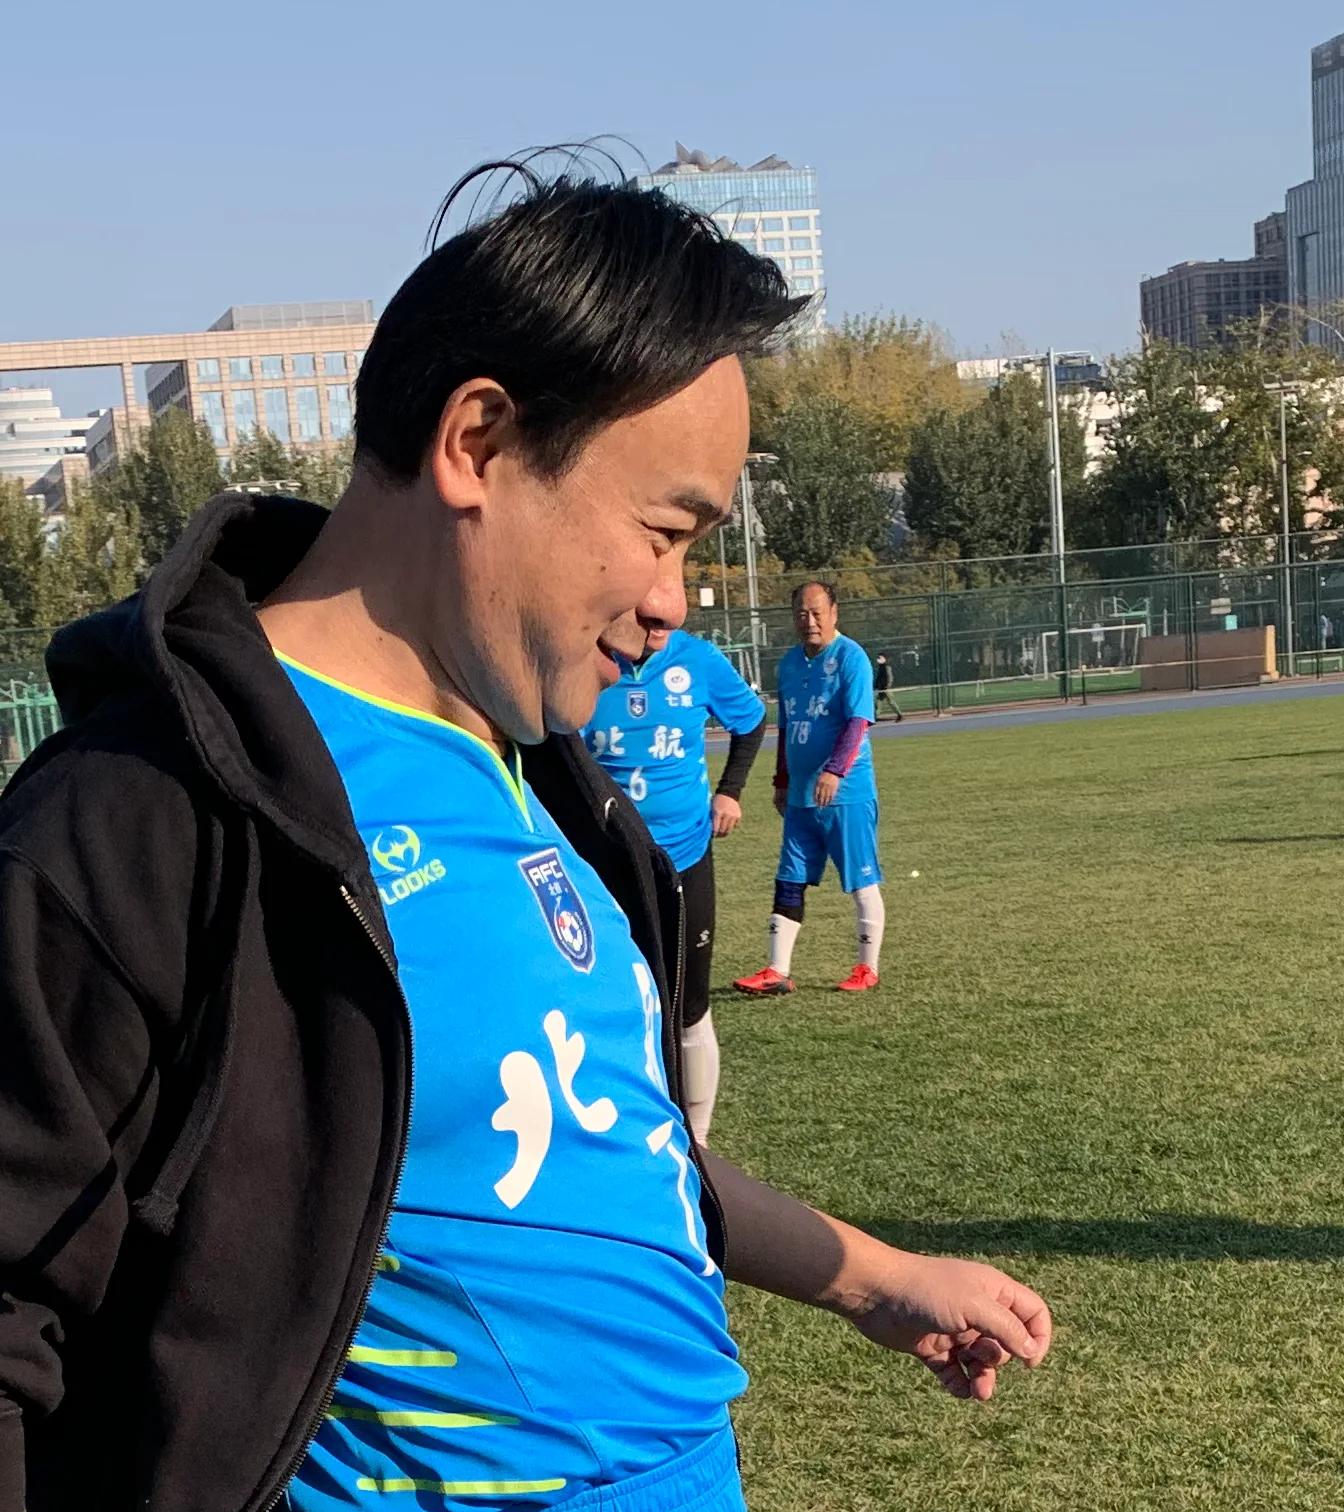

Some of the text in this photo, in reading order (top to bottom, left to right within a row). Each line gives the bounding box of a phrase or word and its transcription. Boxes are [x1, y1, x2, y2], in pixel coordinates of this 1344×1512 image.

[591, 724, 686, 760] 北航
[790, 720, 812, 745] 78
[379, 858, 447, 906] LOOKS
[528, 859, 564, 887] AFC
